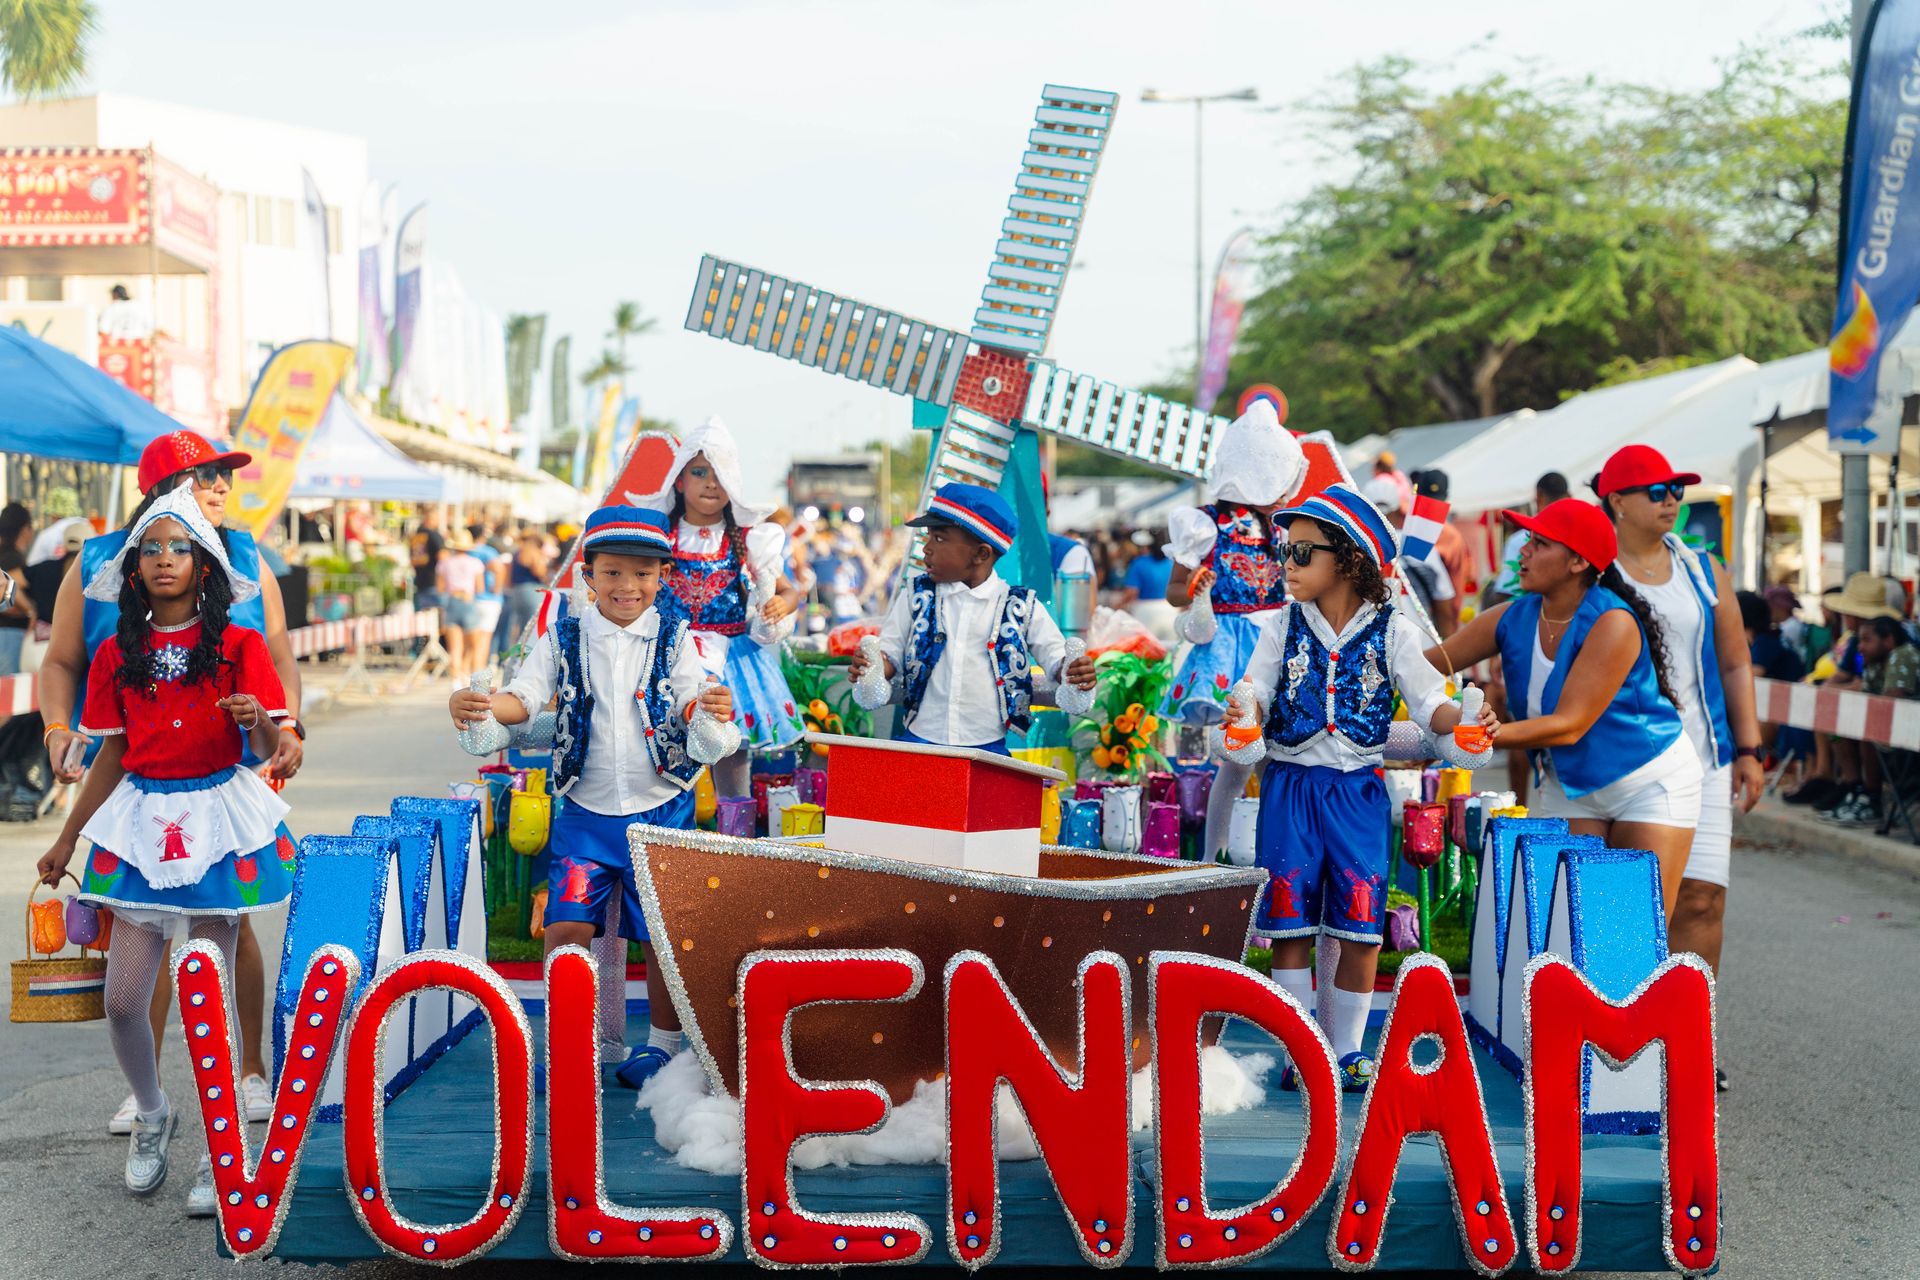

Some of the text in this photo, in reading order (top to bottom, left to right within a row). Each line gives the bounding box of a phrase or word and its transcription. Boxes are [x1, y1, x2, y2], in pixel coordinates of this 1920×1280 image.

[1857, 43, 1920, 279] Guardian Gr
[170, 937, 1721, 1278] VOLENDAM
